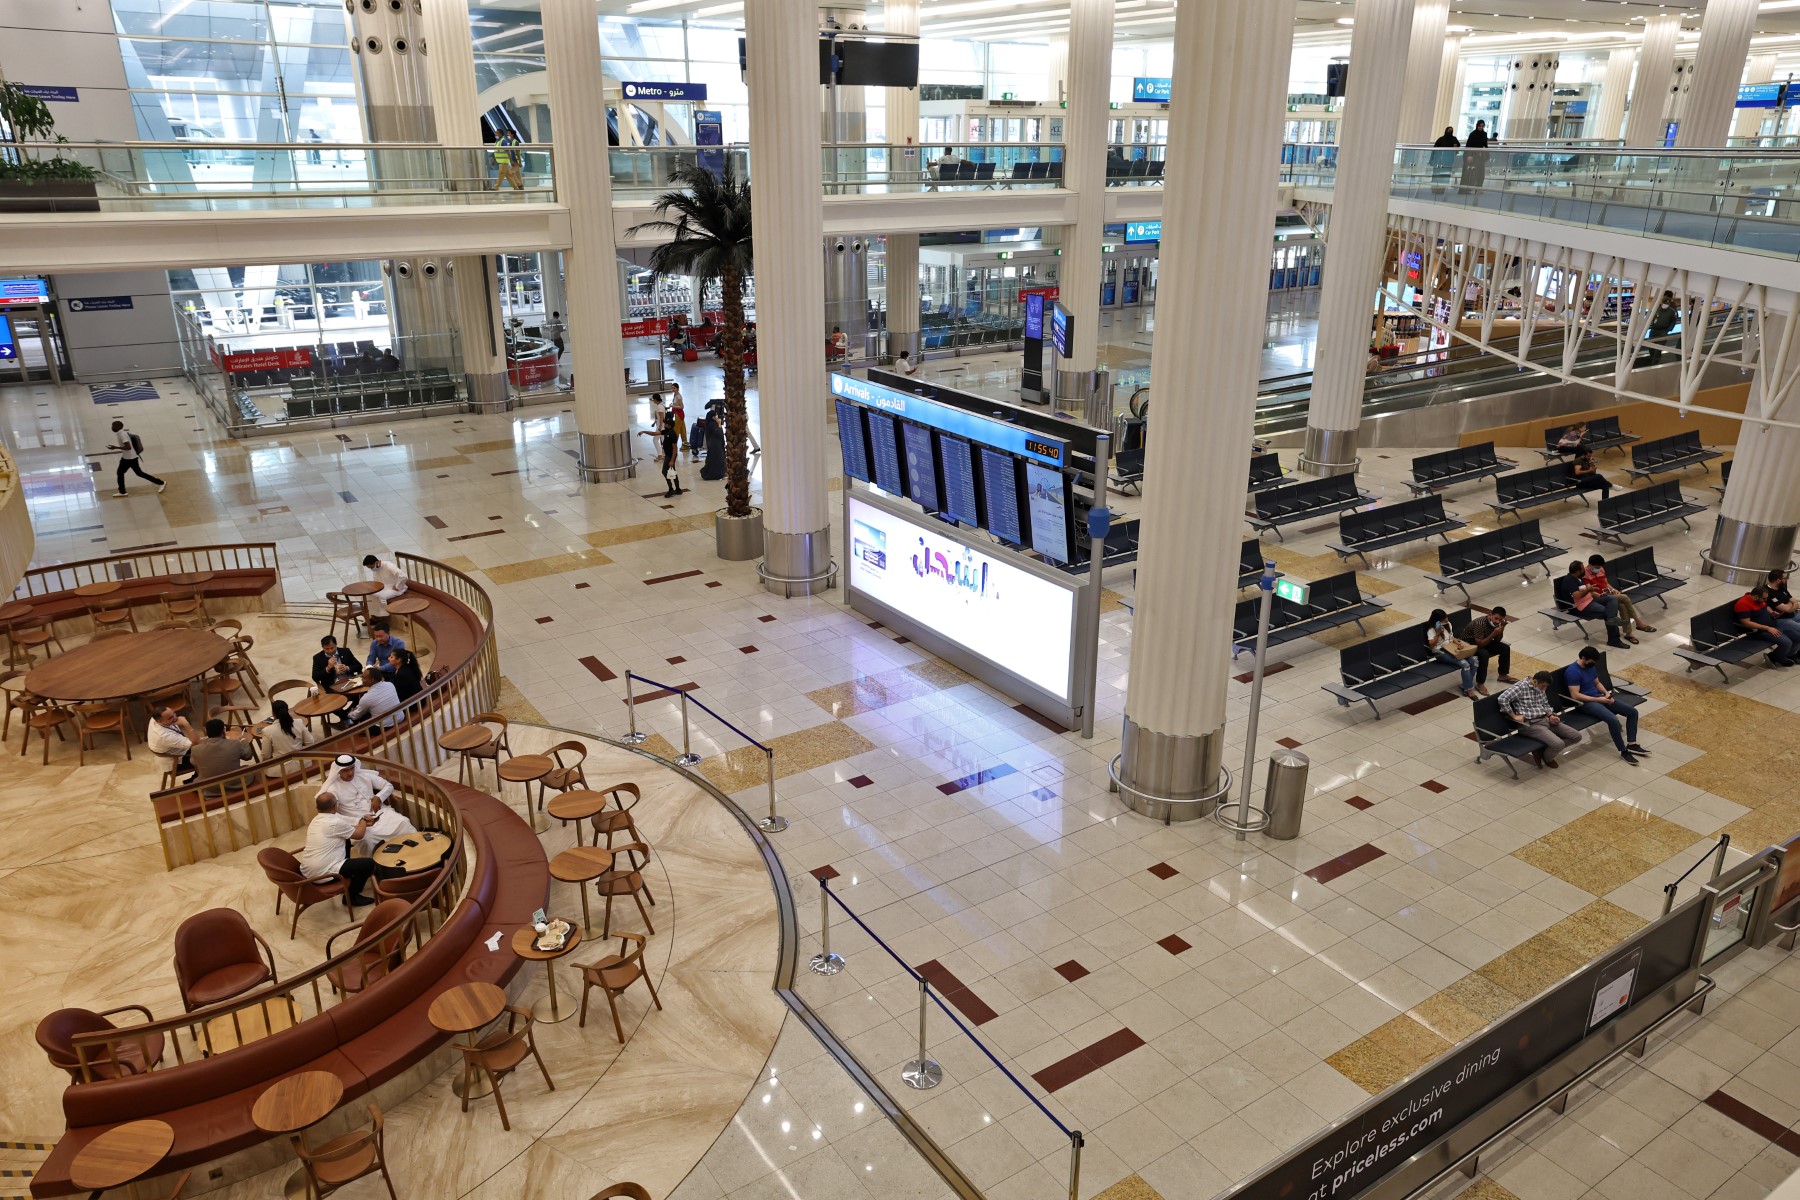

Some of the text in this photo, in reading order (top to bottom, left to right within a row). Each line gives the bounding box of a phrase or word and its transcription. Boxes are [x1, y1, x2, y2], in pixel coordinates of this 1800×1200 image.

[638, 87, 662, 95] Metro
[669, 88, 684, 96] مترو
[844, 383, 870, 400] Arrivals
[876, 396, 906, 412] القادمون
[1312, 1046, 1501, 1180] Explore exclusive dining
[1308, 1106, 1444, 1200] at priceless.com
